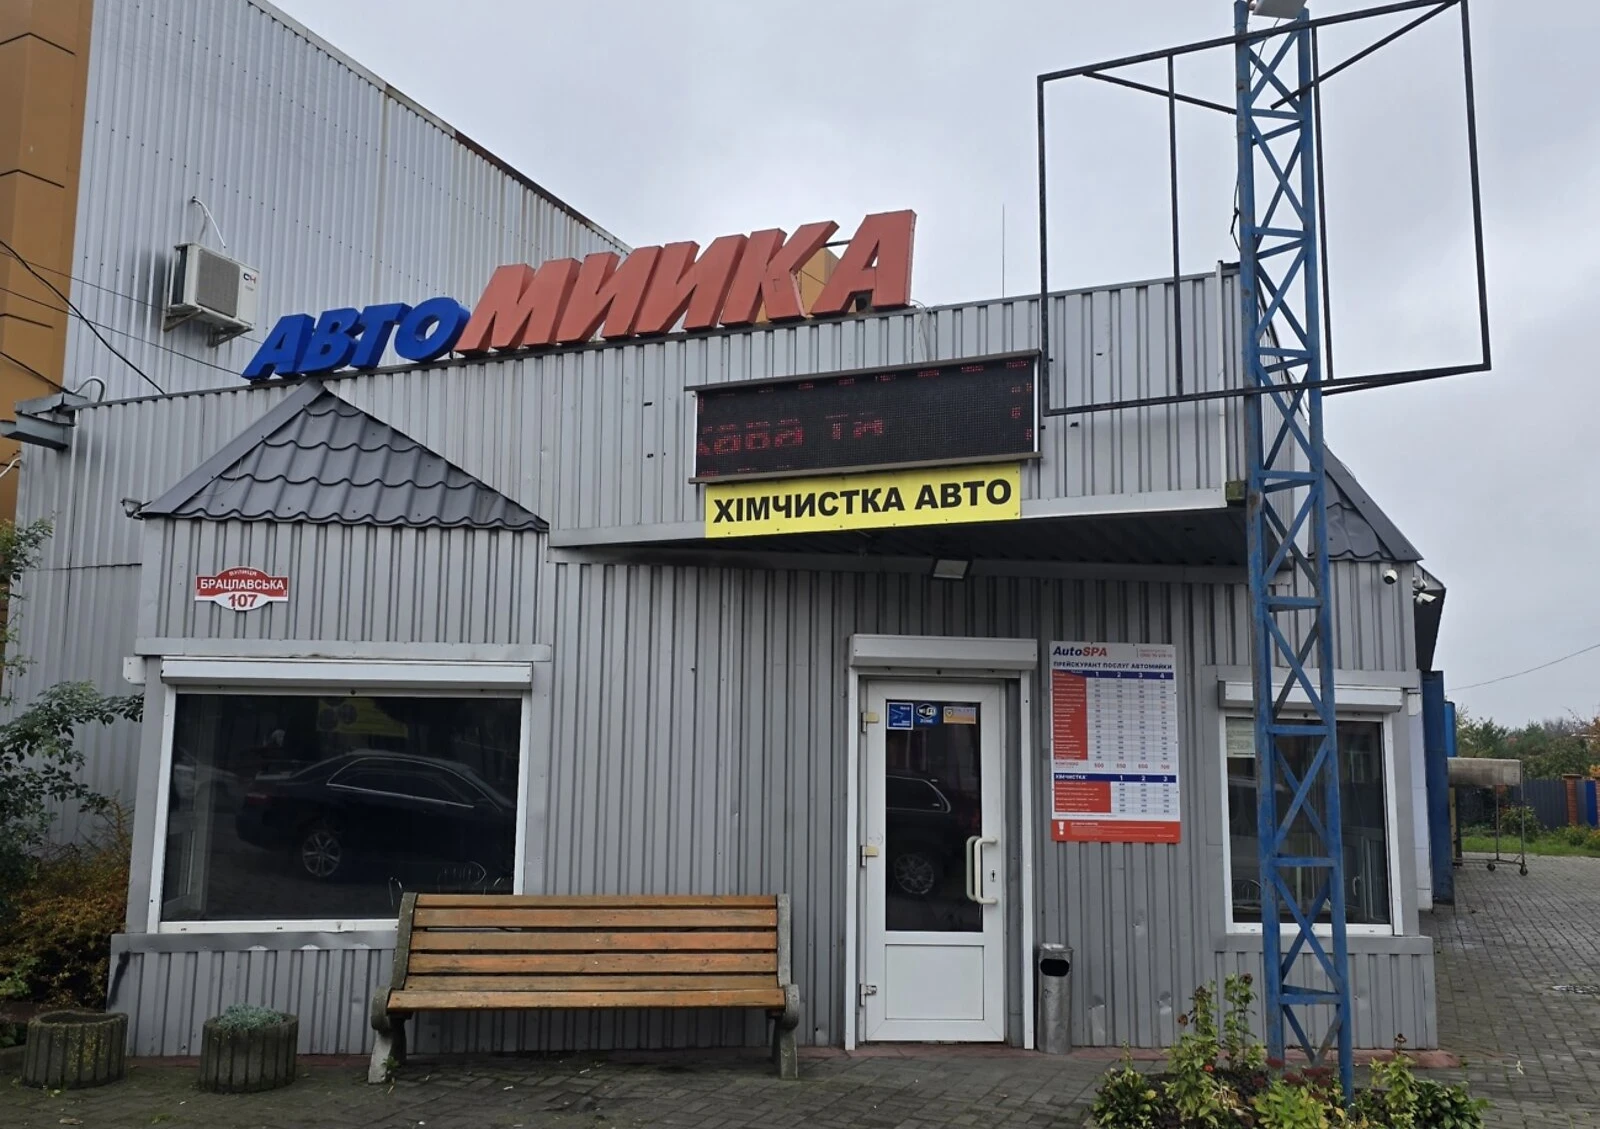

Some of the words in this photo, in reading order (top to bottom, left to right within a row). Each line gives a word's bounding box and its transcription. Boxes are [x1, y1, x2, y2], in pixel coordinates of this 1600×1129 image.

[713, 486, 904, 524] ХІМЧИСТКА
[915, 478, 1012, 511] АВТО
[200, 578, 285, 591] БРАЦЛАВСЬКА
[228, 593, 258, 608] 107
[1053, 646, 1107, 657] AutoSPA
